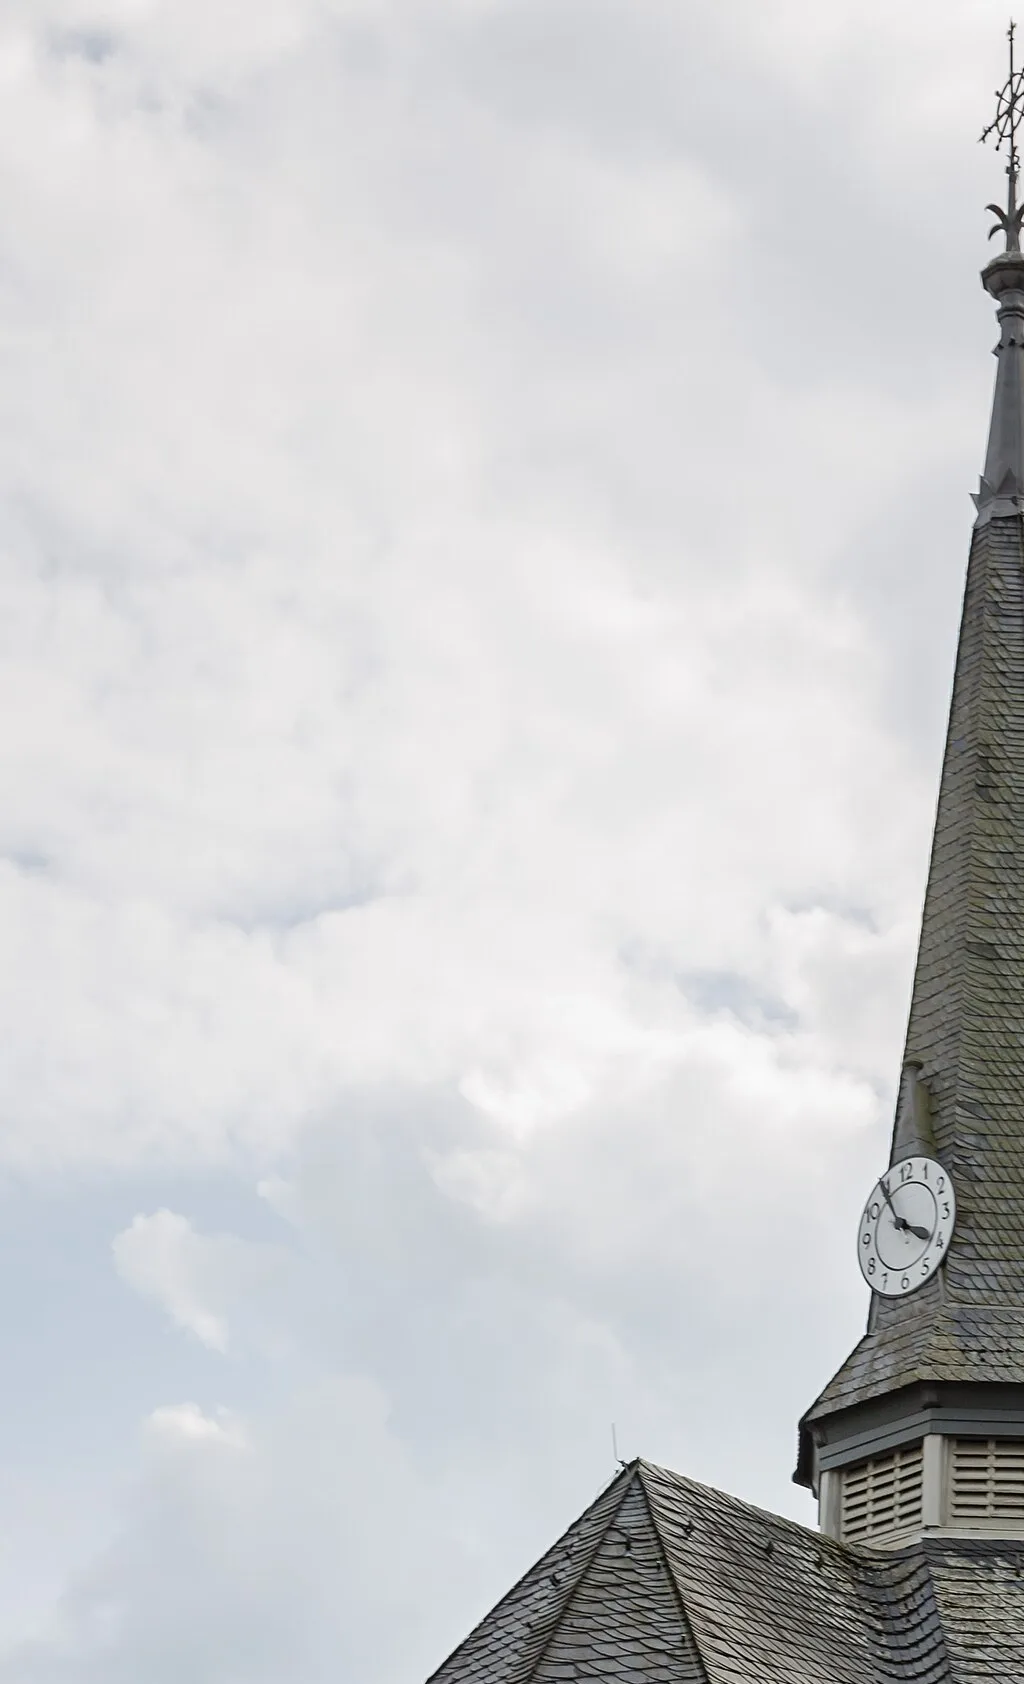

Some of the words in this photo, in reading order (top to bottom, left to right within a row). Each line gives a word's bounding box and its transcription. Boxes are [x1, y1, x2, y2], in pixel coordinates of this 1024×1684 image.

[900, 1162, 913, 1182] 12
[923, 1162, 928, 1180] 1
[936, 1176, 945, 1195] 2
[864, 1202, 880, 1223] 10
[942, 1201, 950, 1220] 3
[862, 1233, 871, 1250] 9
[936, 1231, 944, 1249] 4
[867, 1257, 876, 1275] 8
[921, 1257, 930, 1276] 5
[881, 1272, 888, 1291] 7
[901, 1272, 910, 1290] 6
